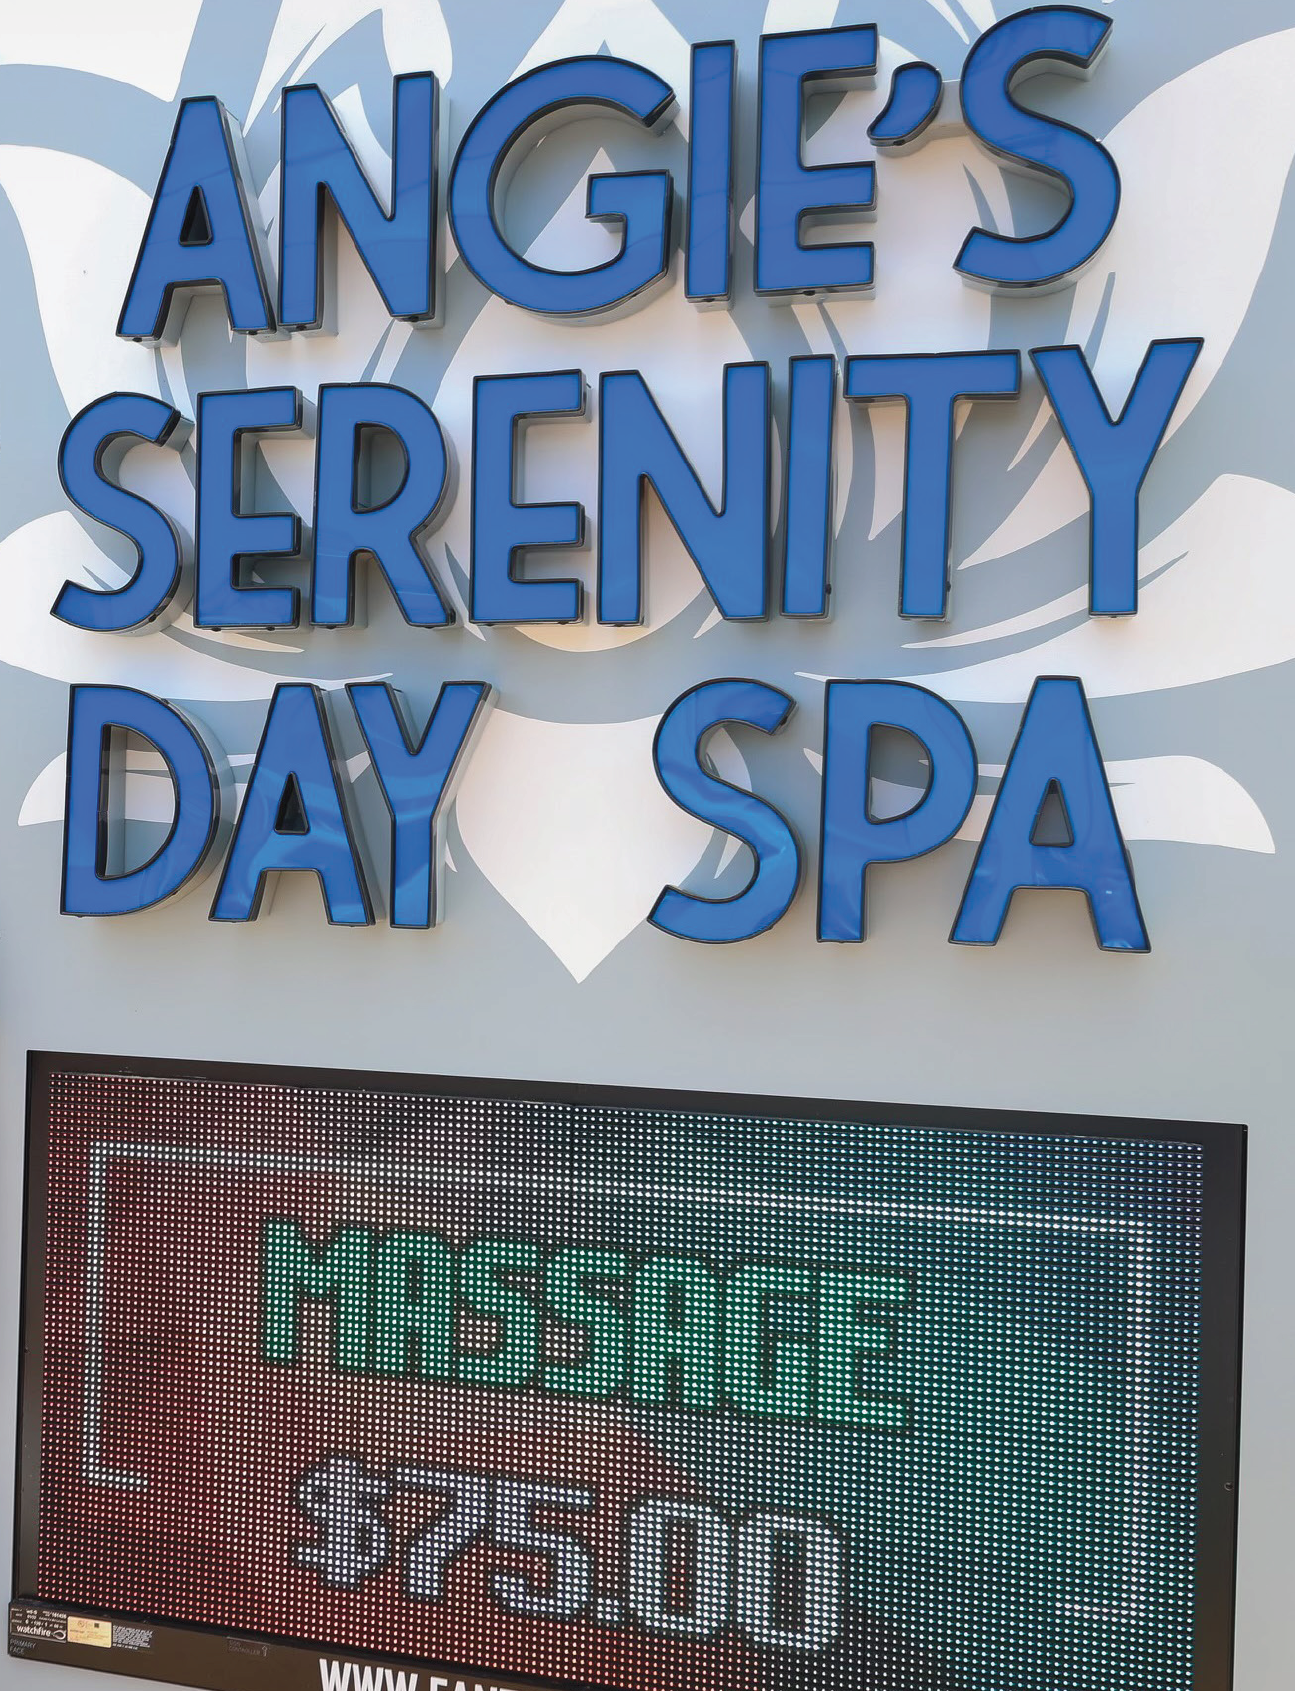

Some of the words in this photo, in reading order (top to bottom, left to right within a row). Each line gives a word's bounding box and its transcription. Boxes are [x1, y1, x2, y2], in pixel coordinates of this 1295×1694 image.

[114, 4, 1123, 344] ANGIE'S
[49, 337, 1205, 633] SERENITY
[60, 681, 495, 930] DAY
[646, 675, 1152, 953] SPA
[261, 1216, 907, 1432] MASSAGE
[16, 1625, 51, 1637] watchfire
[297, 1453, 844, 1655] $75.00
